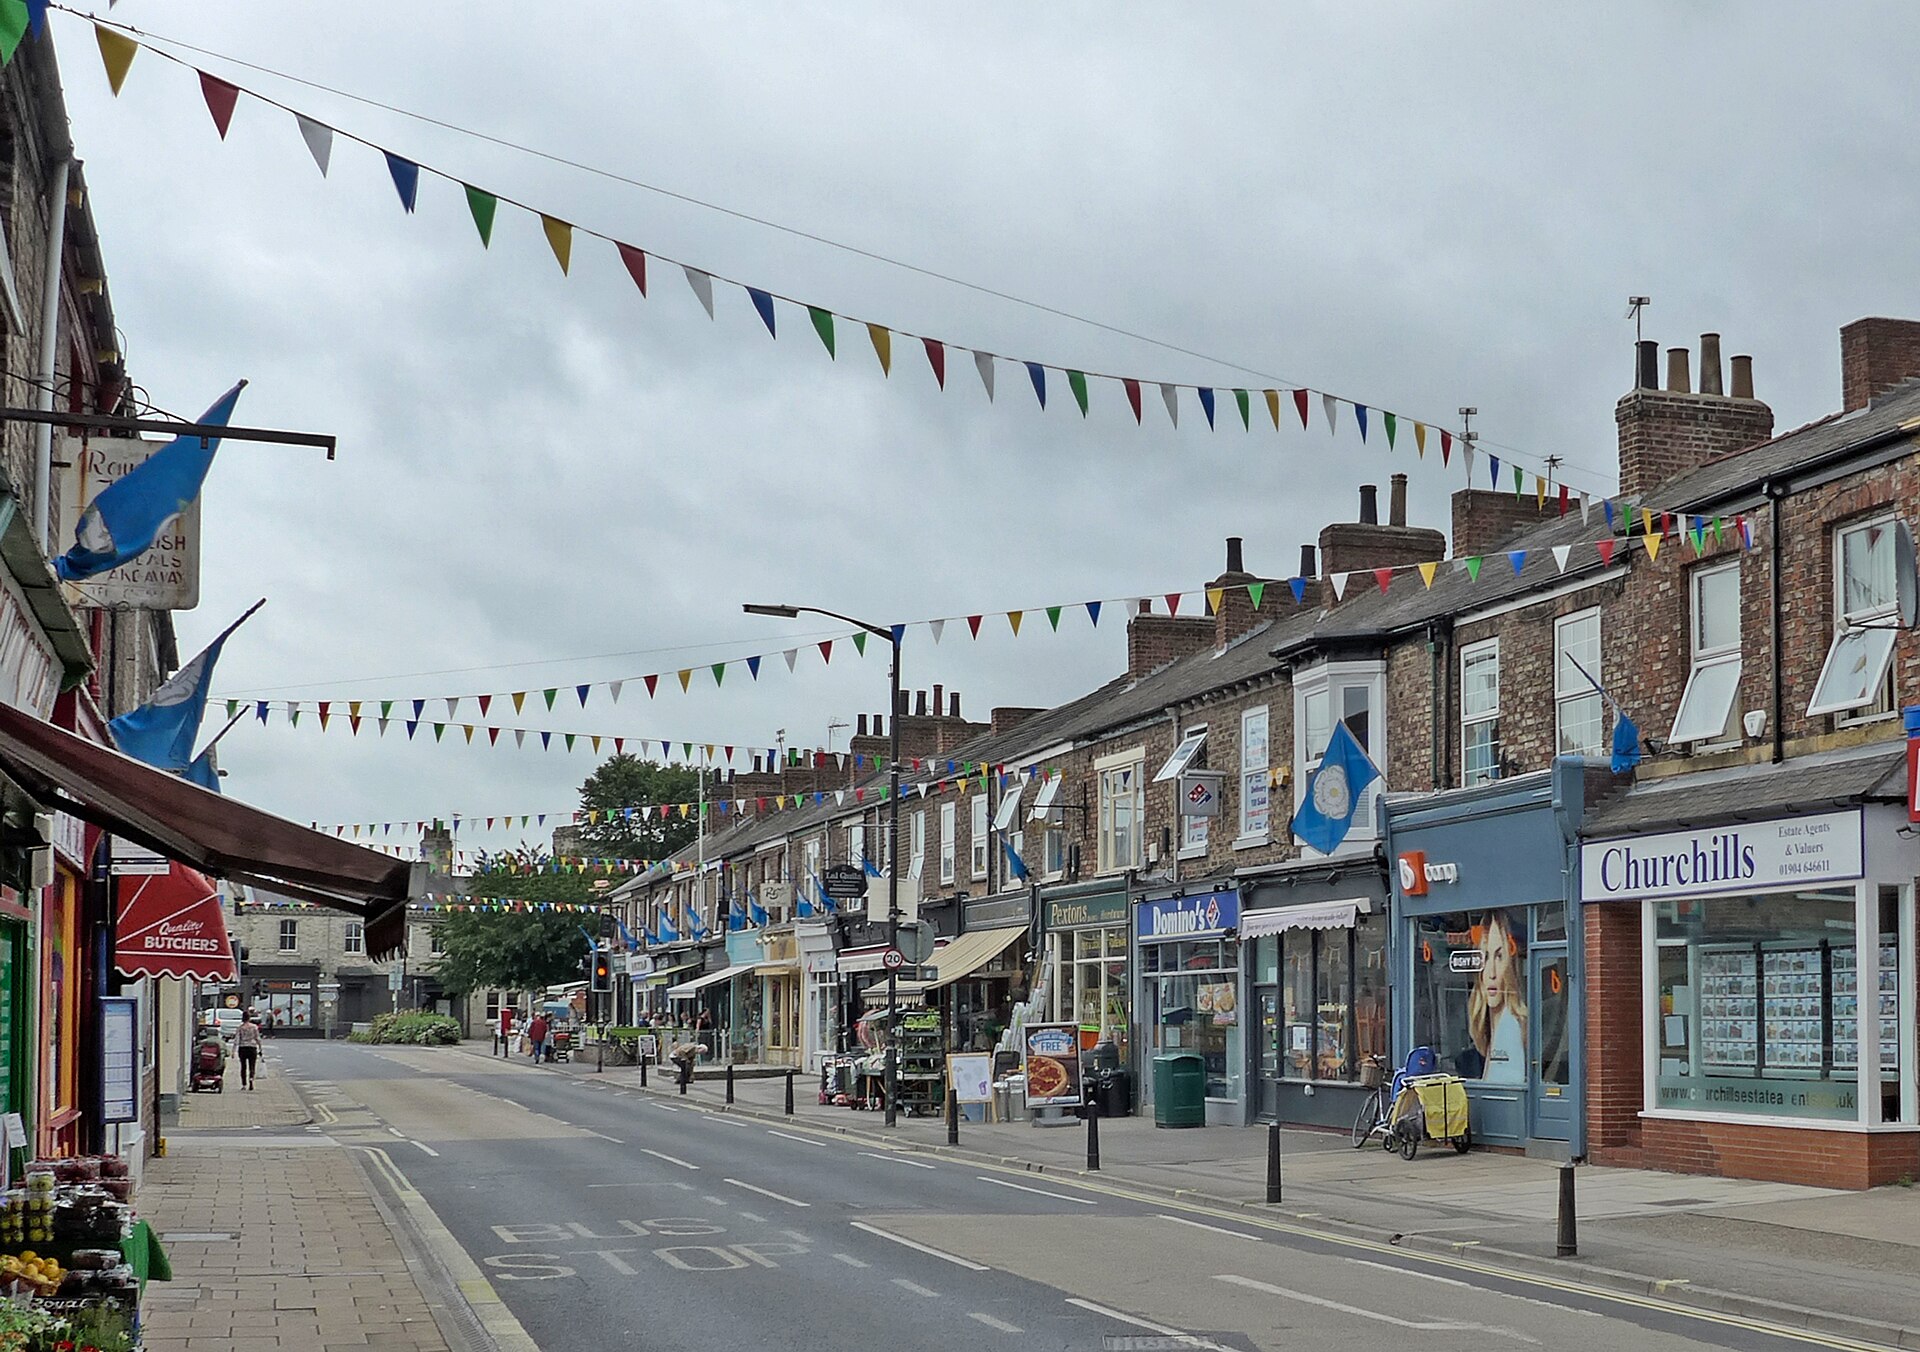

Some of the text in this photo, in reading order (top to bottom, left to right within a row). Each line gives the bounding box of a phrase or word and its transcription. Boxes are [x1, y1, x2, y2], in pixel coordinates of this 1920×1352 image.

[1778, 822, 1831, 838] Estate Agents
[1784, 842, 1824, 856] & Valuers
[1600, 833, 1756, 892] Churchills
[1779, 861, 1830, 876] 01904 646611
[1050, 903, 1089, 926] Pextons
[1152, 900, 1206, 936] Domino's
[158, 920, 204, 936] Quality
[144, 936, 219, 952] BUTCHERS
[886, 954, 900, 963] 20
[1041, 1041, 1062, 1052] FREE
[490, 1217, 727, 1244] BUS
[483, 1243, 811, 1280] STOP
